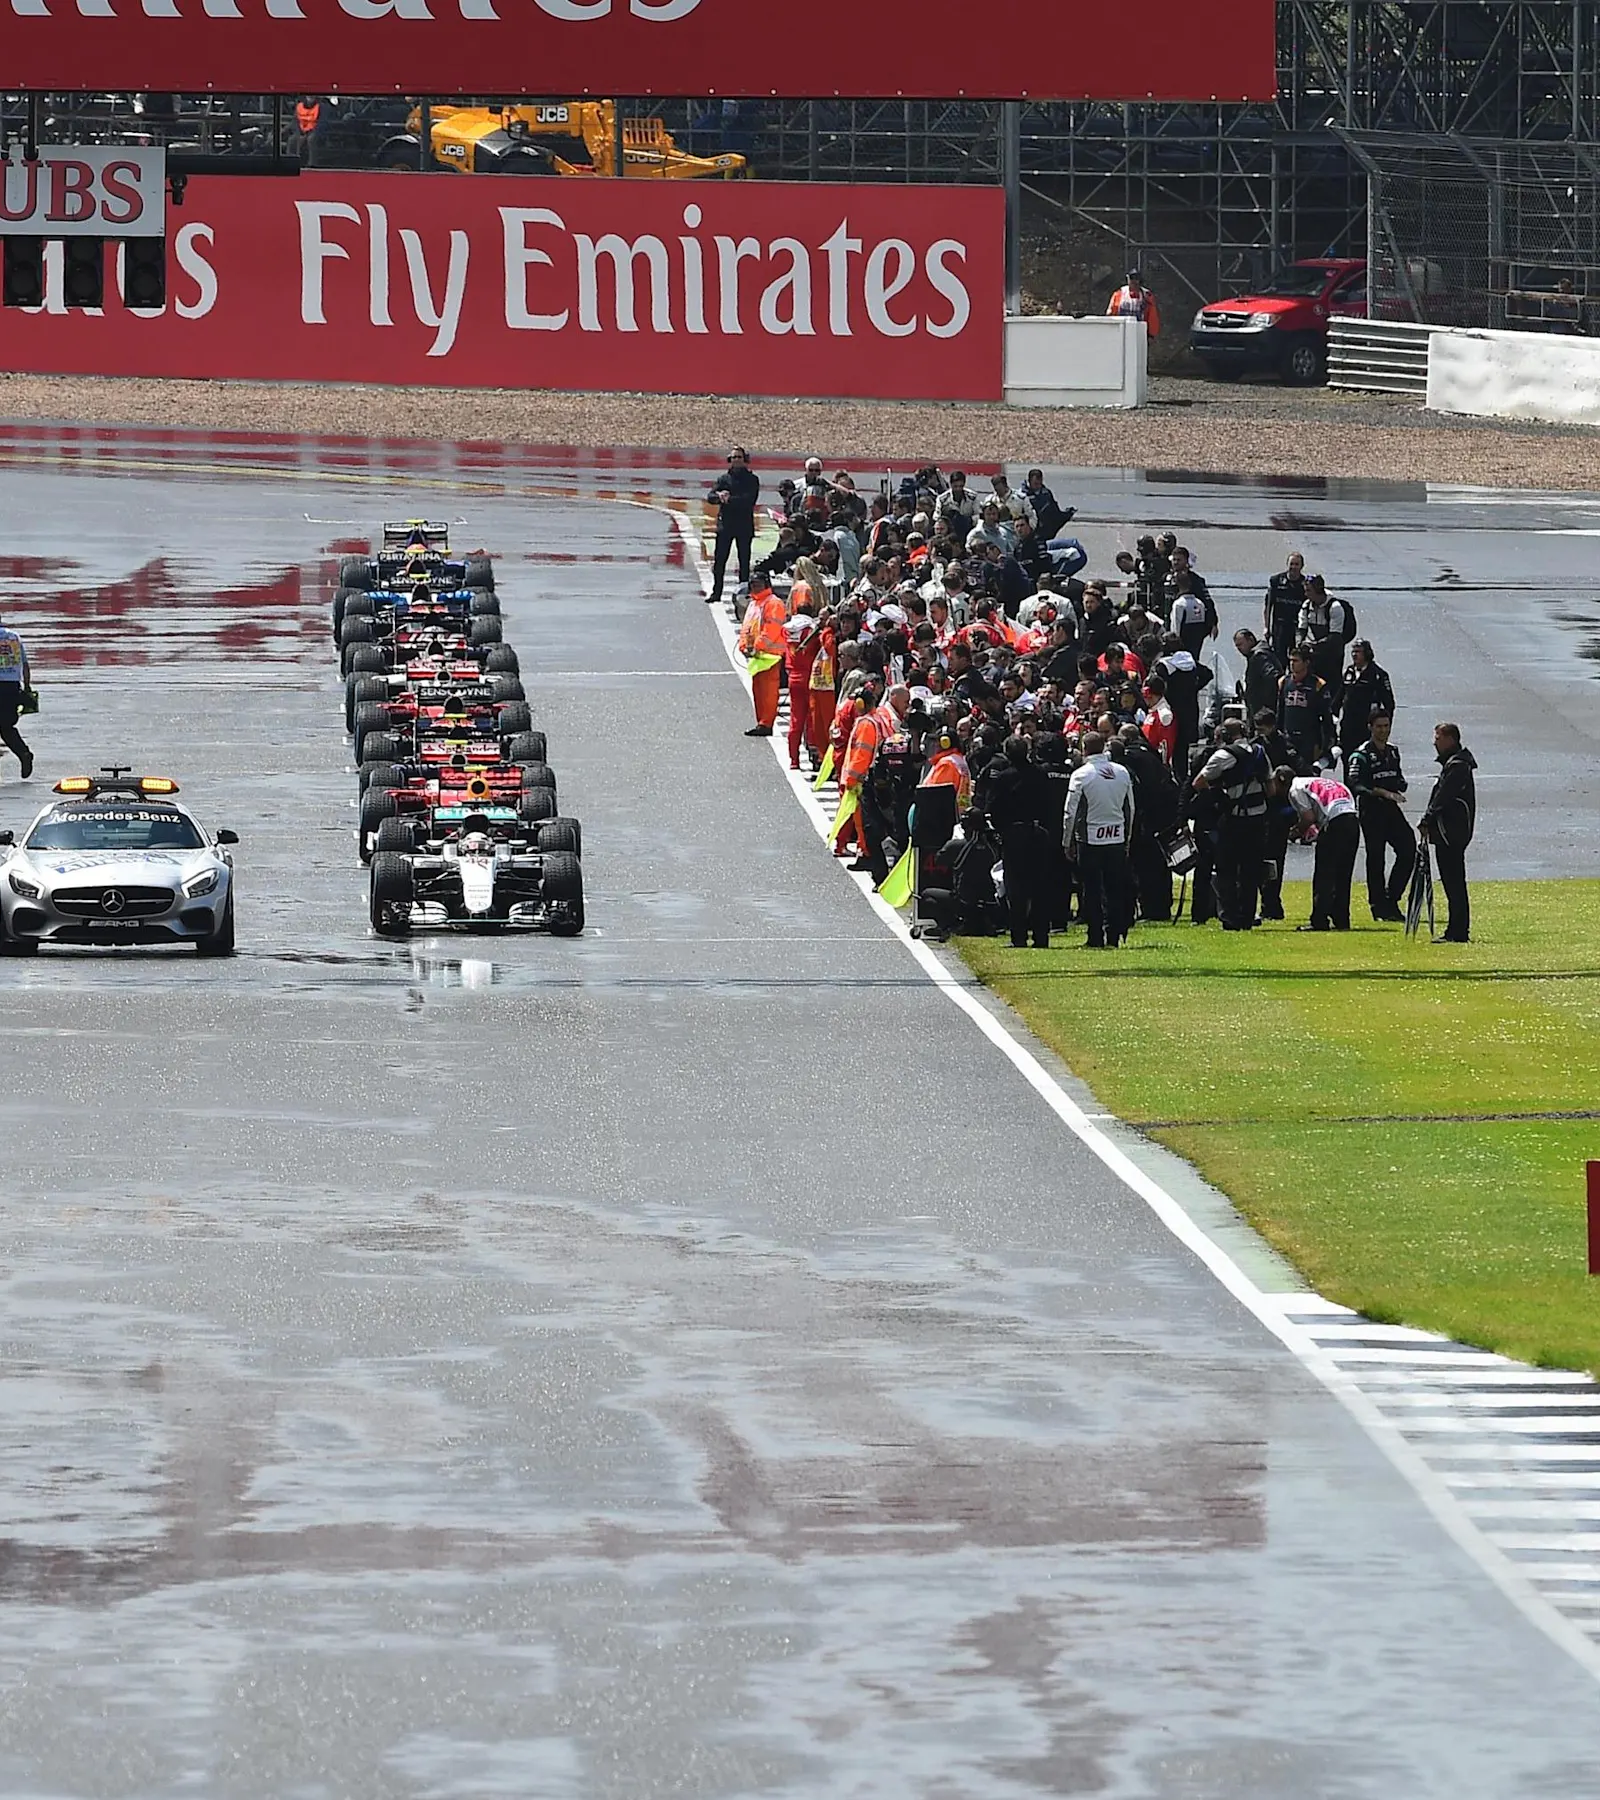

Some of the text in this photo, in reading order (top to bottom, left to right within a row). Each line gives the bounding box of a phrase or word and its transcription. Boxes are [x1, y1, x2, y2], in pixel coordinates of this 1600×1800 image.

[536, 106, 568, 122] JCB
[441, 145, 465, 156] JCB
[295, 200, 469, 357] Fly
[498, 203, 972, 339] Emirates
[51, 810, 182, 825] Mercedes-Benz
[1096, 826, 1120, 839] ONE
